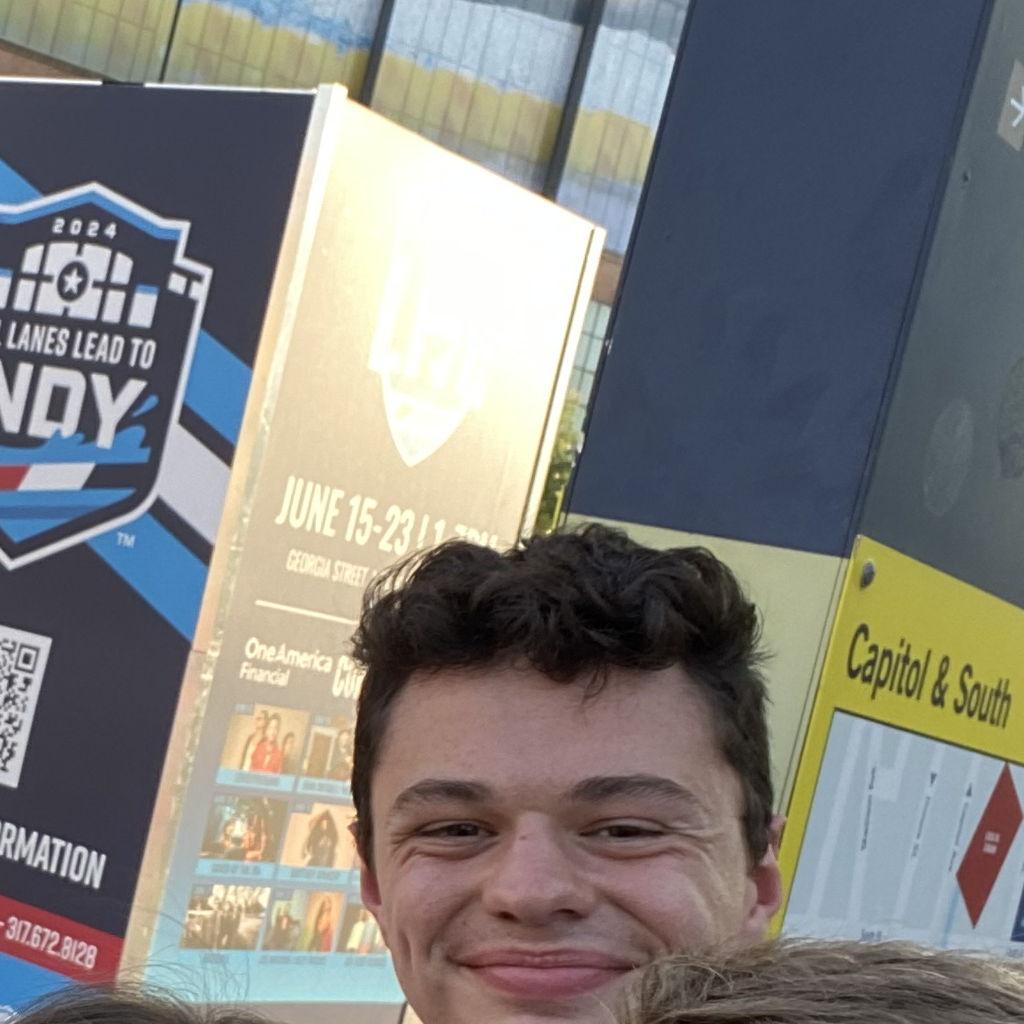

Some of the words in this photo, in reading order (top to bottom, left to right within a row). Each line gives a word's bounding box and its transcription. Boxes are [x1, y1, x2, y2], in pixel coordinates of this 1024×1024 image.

[52, 217, 118, 239] 2024
[7, 322, 69, 357] LANES
[72, 334, 123, 364] LEAD
[131, 338, 157, 370] TO
[275, 475, 346, 538] JUNE
[344, 494, 416, 556] 15-23
[286, 548, 331, 579] GEORGIA
[331, 560, 371, 588] STREET
[239, 662, 290, 688] Financial
[244, 636, 333, 674] OneAmerica
[846, 623, 932, 701] Capitol
[931, 655, 952, 708] &
[953, 663, 1013, 729] South
[4, 915, 98, 971] 317.672.8128
